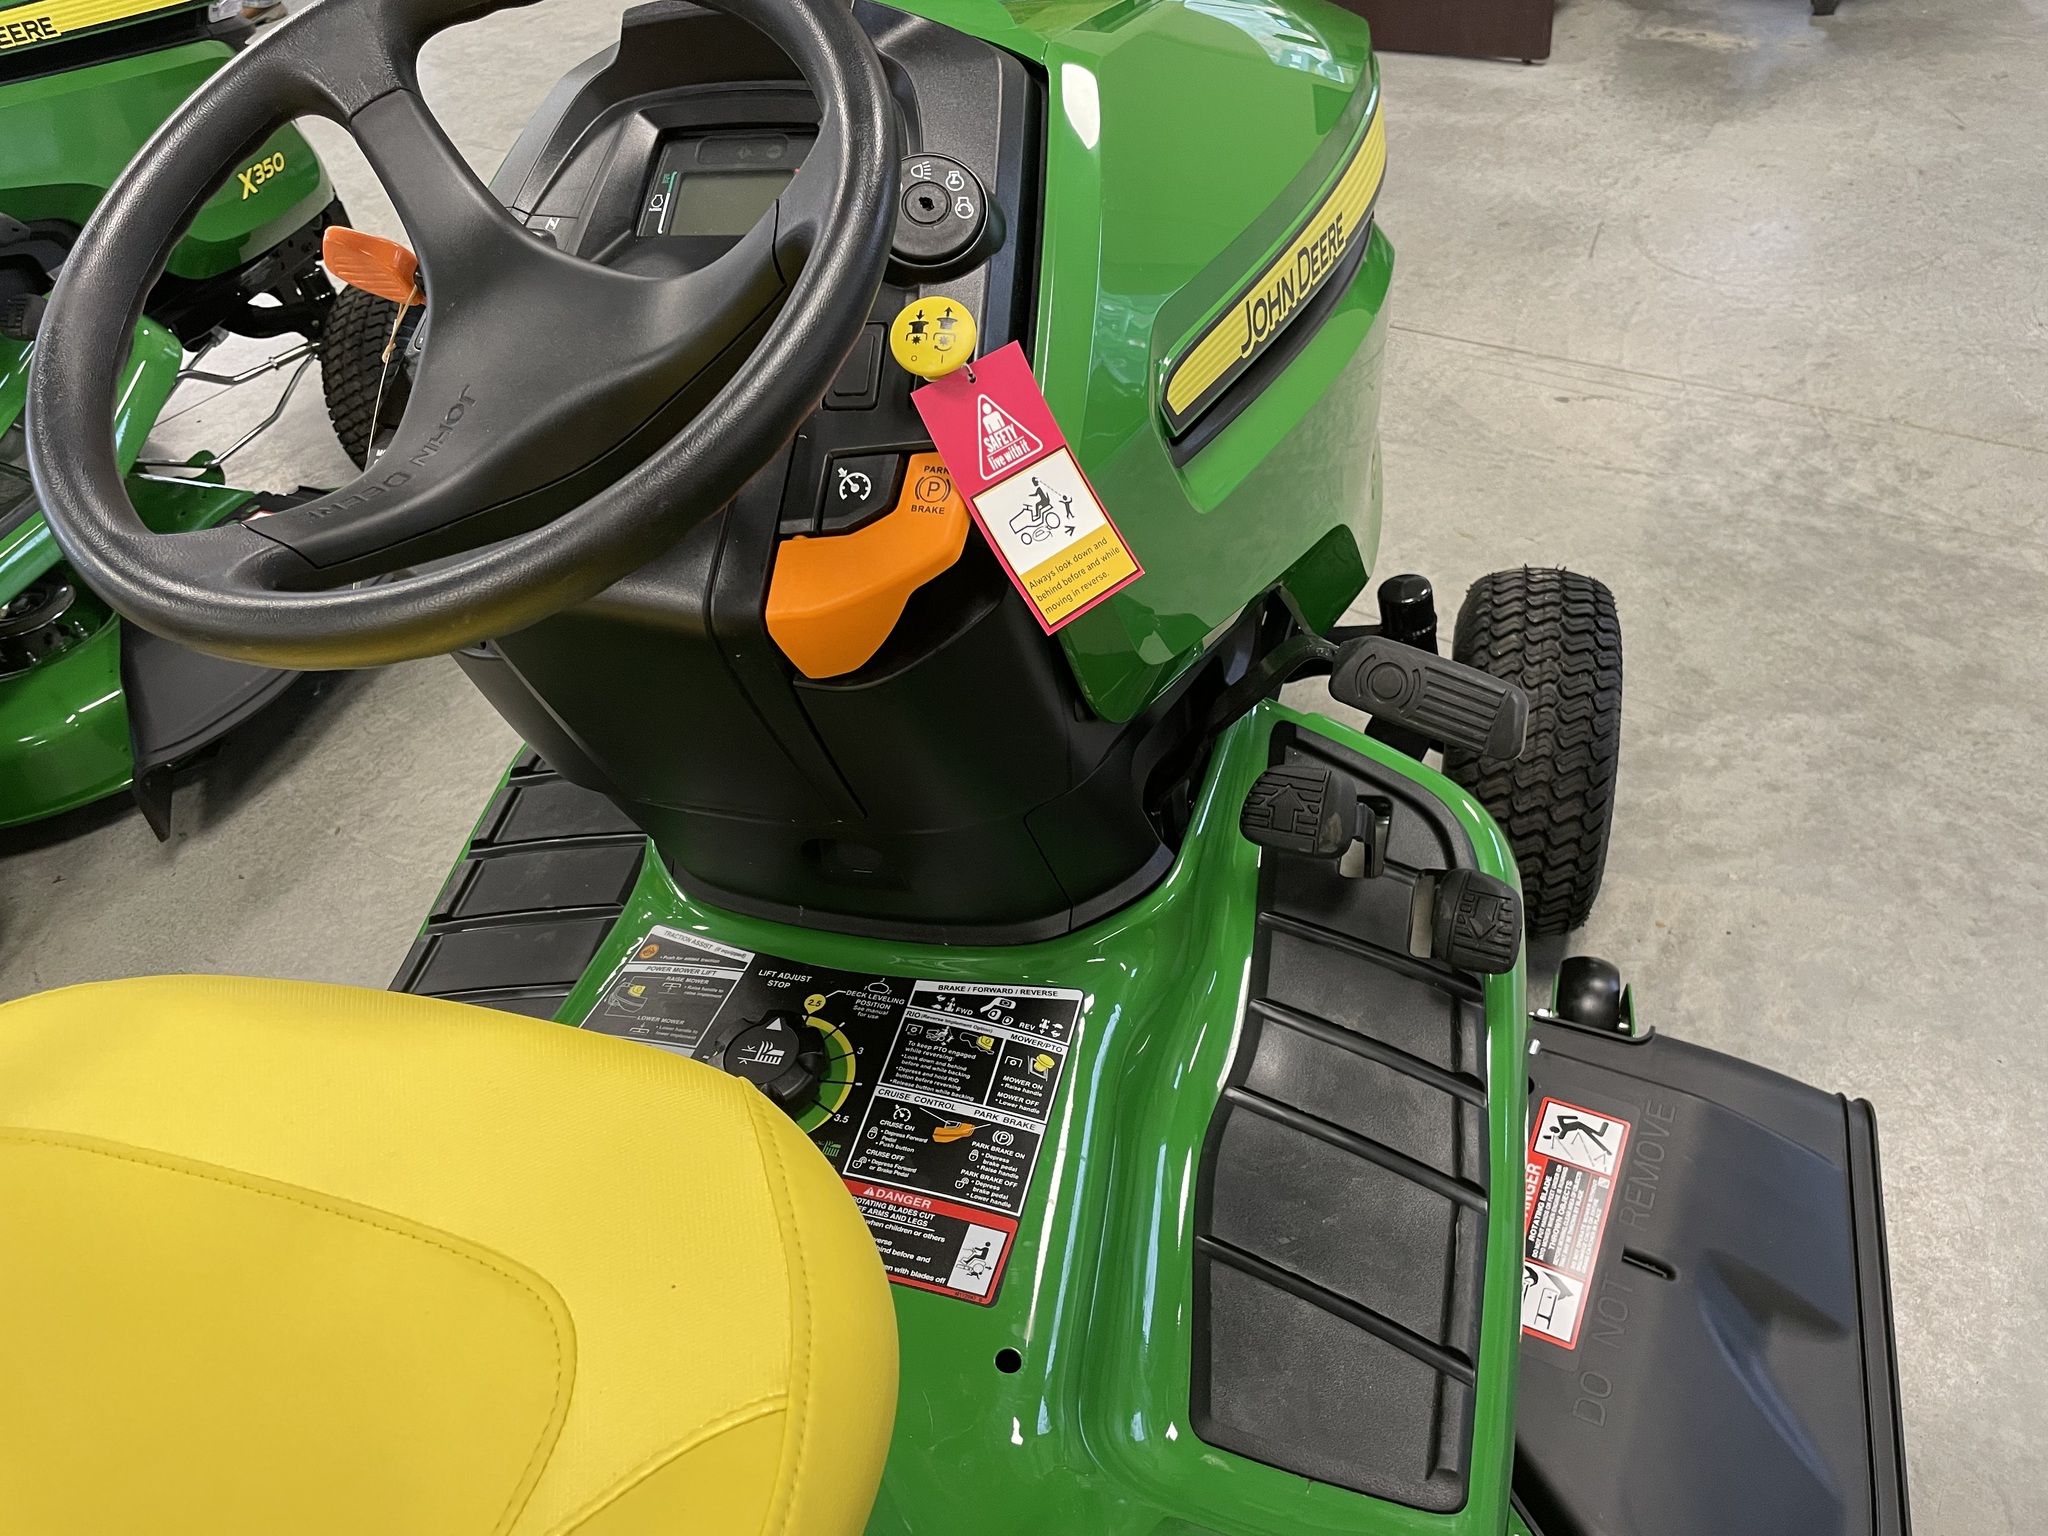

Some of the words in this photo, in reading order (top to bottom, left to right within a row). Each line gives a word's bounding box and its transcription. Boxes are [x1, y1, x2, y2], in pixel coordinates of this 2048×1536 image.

[0, 16, 59, 47] EERE
[236, 151, 286, 200] X350
[1240, 267, 1296, 356] JOHN
[1297, 211, 1346, 298] DEERE
[410, 383, 477, 468] JOHN
[983, 423, 1018, 454] SAFETY
[987, 455, 1007, 471] live
[1003, 443, 1024, 463] with
[1019, 439, 1031, 454] it
[910, 504, 946, 515] BRAKE
[1029, 569, 1056, 590] Always
[1055, 559, 1072, 574] look
[1073, 546, 1094, 563] down
[1094, 536, 1108, 550] and
[1036, 581, 1063, 602] behind
[1062, 567, 1087, 586] before
[1087, 557, 1101, 572] and
[1100, 546, 1121, 563] while
[1045, 593, 1074, 615] moving
[1072, 589, 1081, 598] in
[1080, 571, 1110, 593] reverse.
[664, 930, 691, 943] TRACTION
[689, 938, 713, 950] ASSIST
[672, 967, 701, 975] MOWER
[758, 969, 778, 978] LIFT
[777, 971, 813, 983] ADJUST
[685, 977, 710, 985] MOWER
[766, 979, 791, 989] STOP
[845, 989, 868, 999] DECK
[868, 993, 905, 1006] LEVELING
[937, 984, 966, 992] BRAKE
[972, 986, 1014, 995] FORWARD
[1020, 988, 1059, 997] REVERSE
[807, 999, 823, 1007] 2.5
[853, 1004, 865, 1012] See
[865, 1006, 890, 1016] manual
[855, 998, 892, 1011] POSITION
[955, 1006, 974, 1016] FWD
[905, 1010, 921, 1018] RIO
[1018, 1021, 1036, 1031] REV
[856, 1046, 865, 1056] 3
[905, 1046, 922, 1055] while
[916, 1041, 932, 1051] keep
[933, 1045, 948, 1053] PTO
[947, 1049, 977, 1060] engaged
[1010, 1033, 1063, 1053] MOWER/PTO
[901, 1059, 920, 1068] before
[919, 1062, 932, 1070] and
[931, 1065, 948, 1074] while
[947, 1068, 971, 1080] backing
[903, 1053, 918, 1062] Look
[918, 1057, 935, 1065] down
[935, 1059, 947, 1067] and
[946, 1061, 968, 1072] behind
[895, 1071, 915, 1081] button
[914, 1076, 934, 1086] before
[933, 1080, 962, 1092] reversing
[897, 1065, 922, 1076] Depress
[921, 1069, 934, 1078] and
[934, 1071, 948, 1081] hold
[947, 1075, 960, 1084] RIO
[892, 1078, 915, 1088] Release
[915, 1083, 935, 1093] button
[934, 1087, 951, 1096] while
[950, 1090, 975, 1102] backing
[1002, 1075, 1031, 1088] MOWER
[1031, 1082, 1044, 1091] ON
[1004, 1082, 1022, 1092] Raise
[1021, 1086, 1043, 1098] handle
[996, 1091, 1024, 1104] MOWER
[1024, 1098, 1040, 1107] OFF
[998, 1098, 1019, 1109] Lower
[1018, 1103, 1041, 1115] handle
[878, 1088, 911, 1100] CRUISE
[914, 1095, 956, 1112] CONTROL
[973, 1109, 999, 1121] PARK
[1002, 1116, 1037, 1131] BRAKE
[833, 1113, 850, 1124] 3.5
[879, 1119, 904, 1130] CRUISE
[904, 1123, 916, 1132] ON
[881, 1135, 898, 1143] Pedal
[883, 1129, 906, 1139] Depress
[905, 1133, 929, 1144] Forward
[878, 1140, 895, 1149] Push
[894, 1144, 915, 1153] button
[971, 1140, 990, 1151] PARK
[990, 1146, 1014, 1157] BRAKE
[1014, 1152, 1026, 1160] ON
[865, 1148, 891, 1159] CRUISE
[891, 1153, 906, 1162] OFF
[984, 1152, 1010, 1164] Depress
[870, 1158, 894, 1169] Depress
[894, 1163, 918, 1174] Forward
[876, 1166, 893, 1175] Brake
[893, 1169, 910, 1178] Pedal
[980, 1165, 998, 1174] Raise
[998, 1169, 1020, 1180] handle
[982, 1159, 1000, 1168] brake
[1000, 1163, 1018, 1173] pedal
[1618, 1099, 1676, 1232] REMOVE
[960, 1168, 980, 1179] PARK
[979, 1174, 1003, 1185] BRAKE
[1003, 1180, 1019, 1188] OFF
[975, 1180, 1001, 1191] Depress
[972, 1186, 990, 1196] brake
[991, 1190, 1009, 1201] pedal
[1524, 1163, 1542, 1218] NGER
[875, 1188, 932, 1210] DANGER
[969, 1193, 989, 1203] Lower
[989, 1198, 1012, 1208] handle
[887, 1205, 919, 1217] BLADES
[918, 1211, 936, 1221] CUT
[1528, 1201, 1545, 1242] ROTATING
[1540, 1175, 1553, 1203] BLADE
[1548, 1215, 1564, 1250] THROWN
[1558, 1180, 1574, 1215] OBJECTS
[867, 1207, 889, 1218] ARMS
[889, 1213, 908, 1222] AND
[907, 1218, 929, 1227] LEGS
[865, 1219, 884, 1229] when
[884, 1223, 913, 1236] children
[922, 1232, 946, 1243] others
[891, 1249, 915, 1260] before
[915, 1254, 932, 1264] and
[894, 1266, 910, 1275] with
[910, 1270, 935, 1282] blades
[935, 1276, 947, 1284] off
[1591, 1271, 1635, 1349] NOT
[1572, 1370, 1612, 1429] DO
